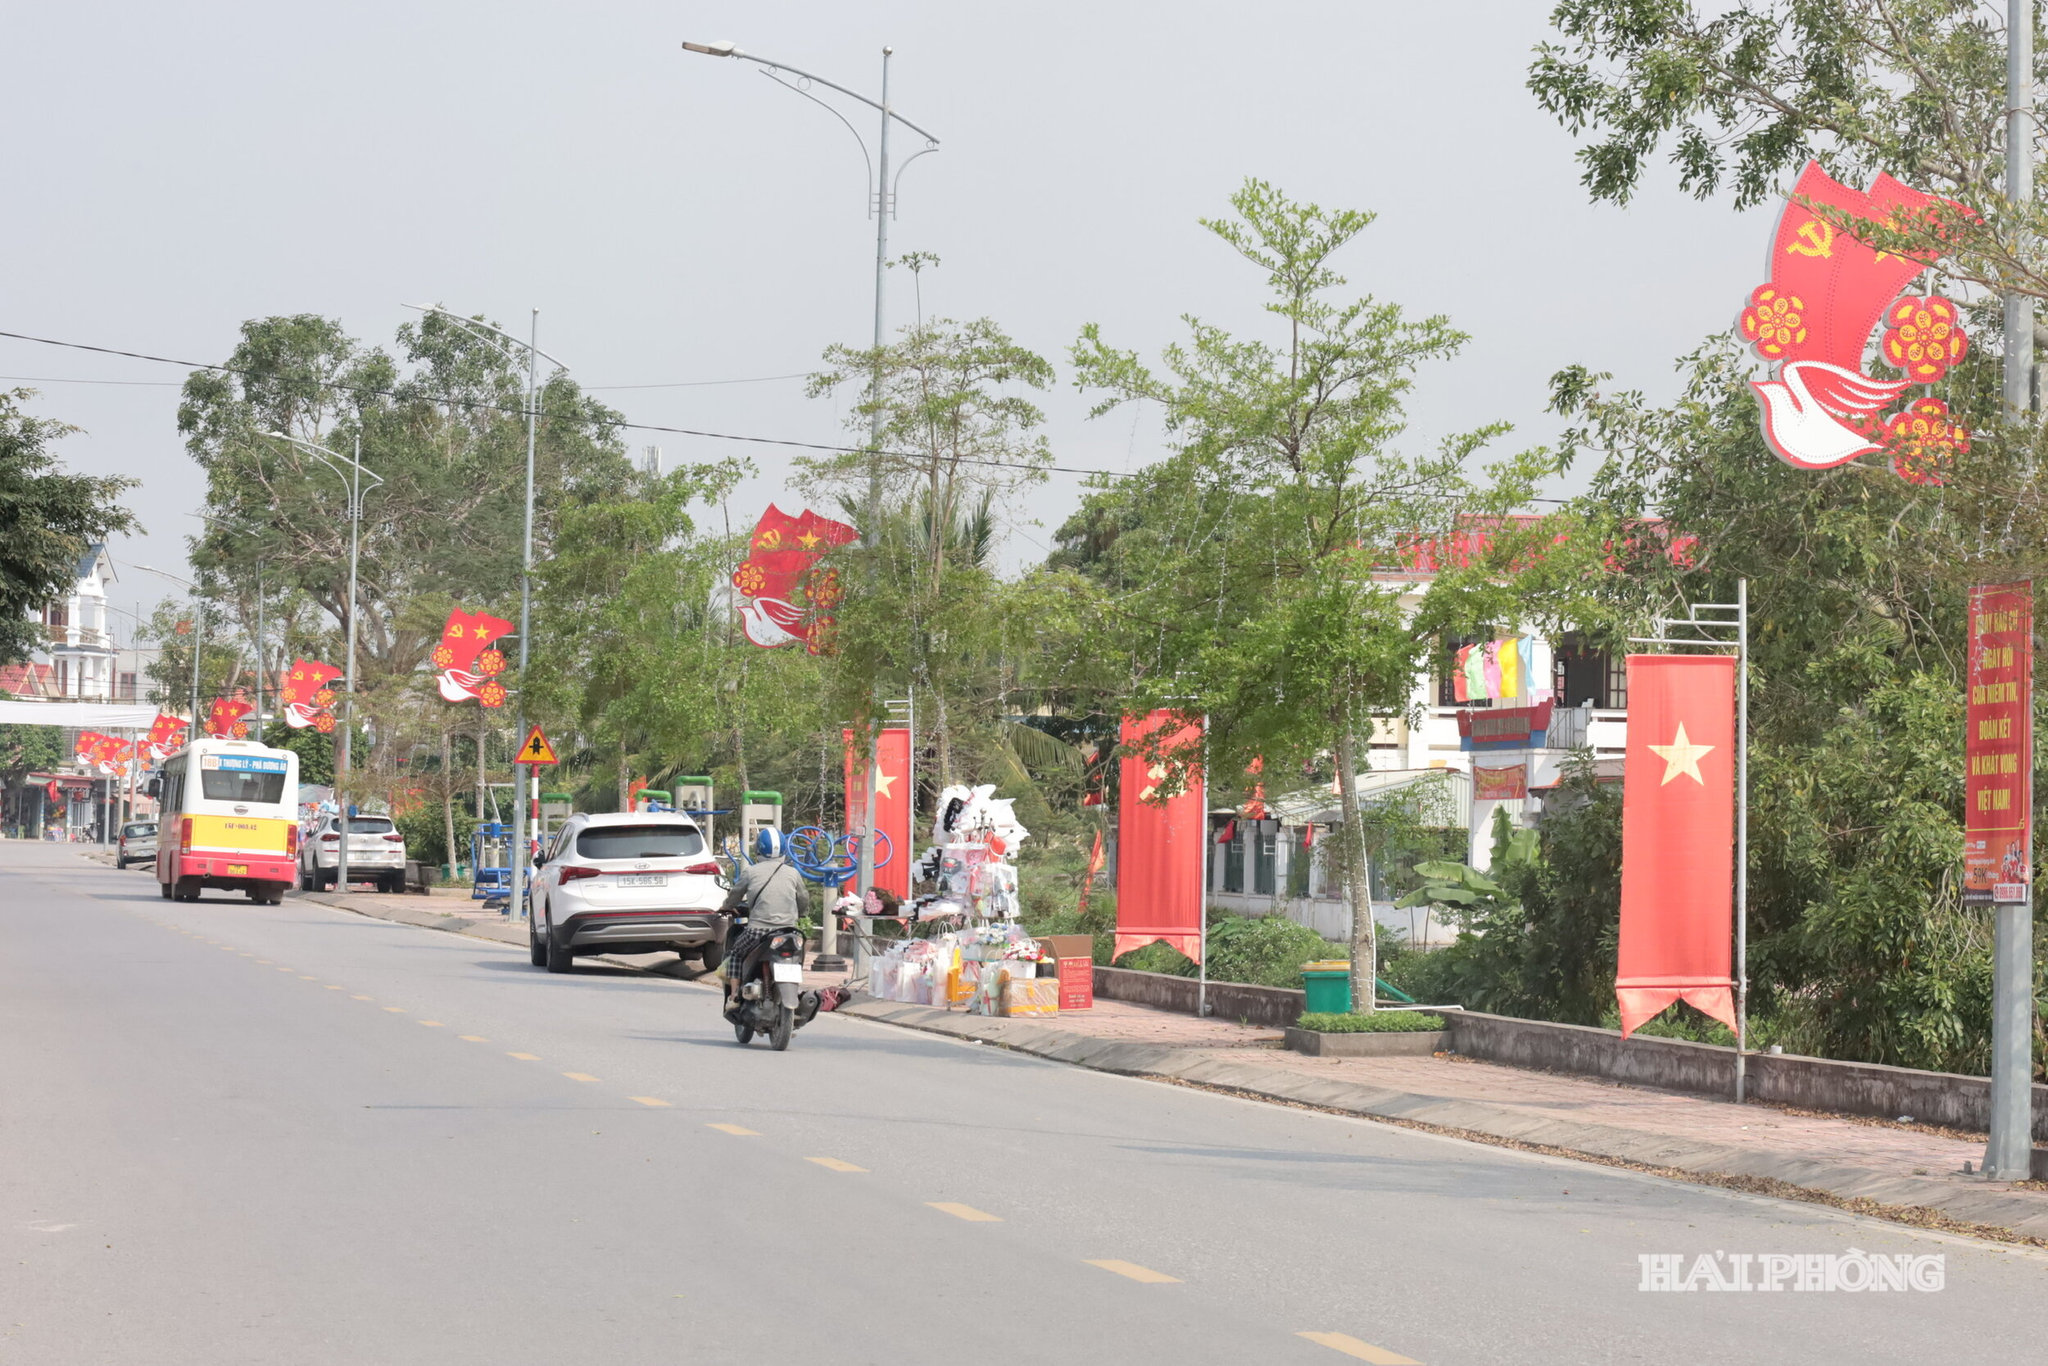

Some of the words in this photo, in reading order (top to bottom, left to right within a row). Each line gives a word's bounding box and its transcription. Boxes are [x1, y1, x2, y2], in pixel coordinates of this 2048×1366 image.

[1983, 643, 2000, 669] NGÀY
[2002, 642, 2013, 672] HỘI
[1999, 710, 2011, 739] KẾT
[1972, 752, 1980, 776] VÀ
[1982, 750, 1999, 775] KHÁT
[2000, 753, 2017, 778] VỌNG
[1978, 785, 1992, 815] VIỆT
[1993, 788, 2011, 811] NAM!
